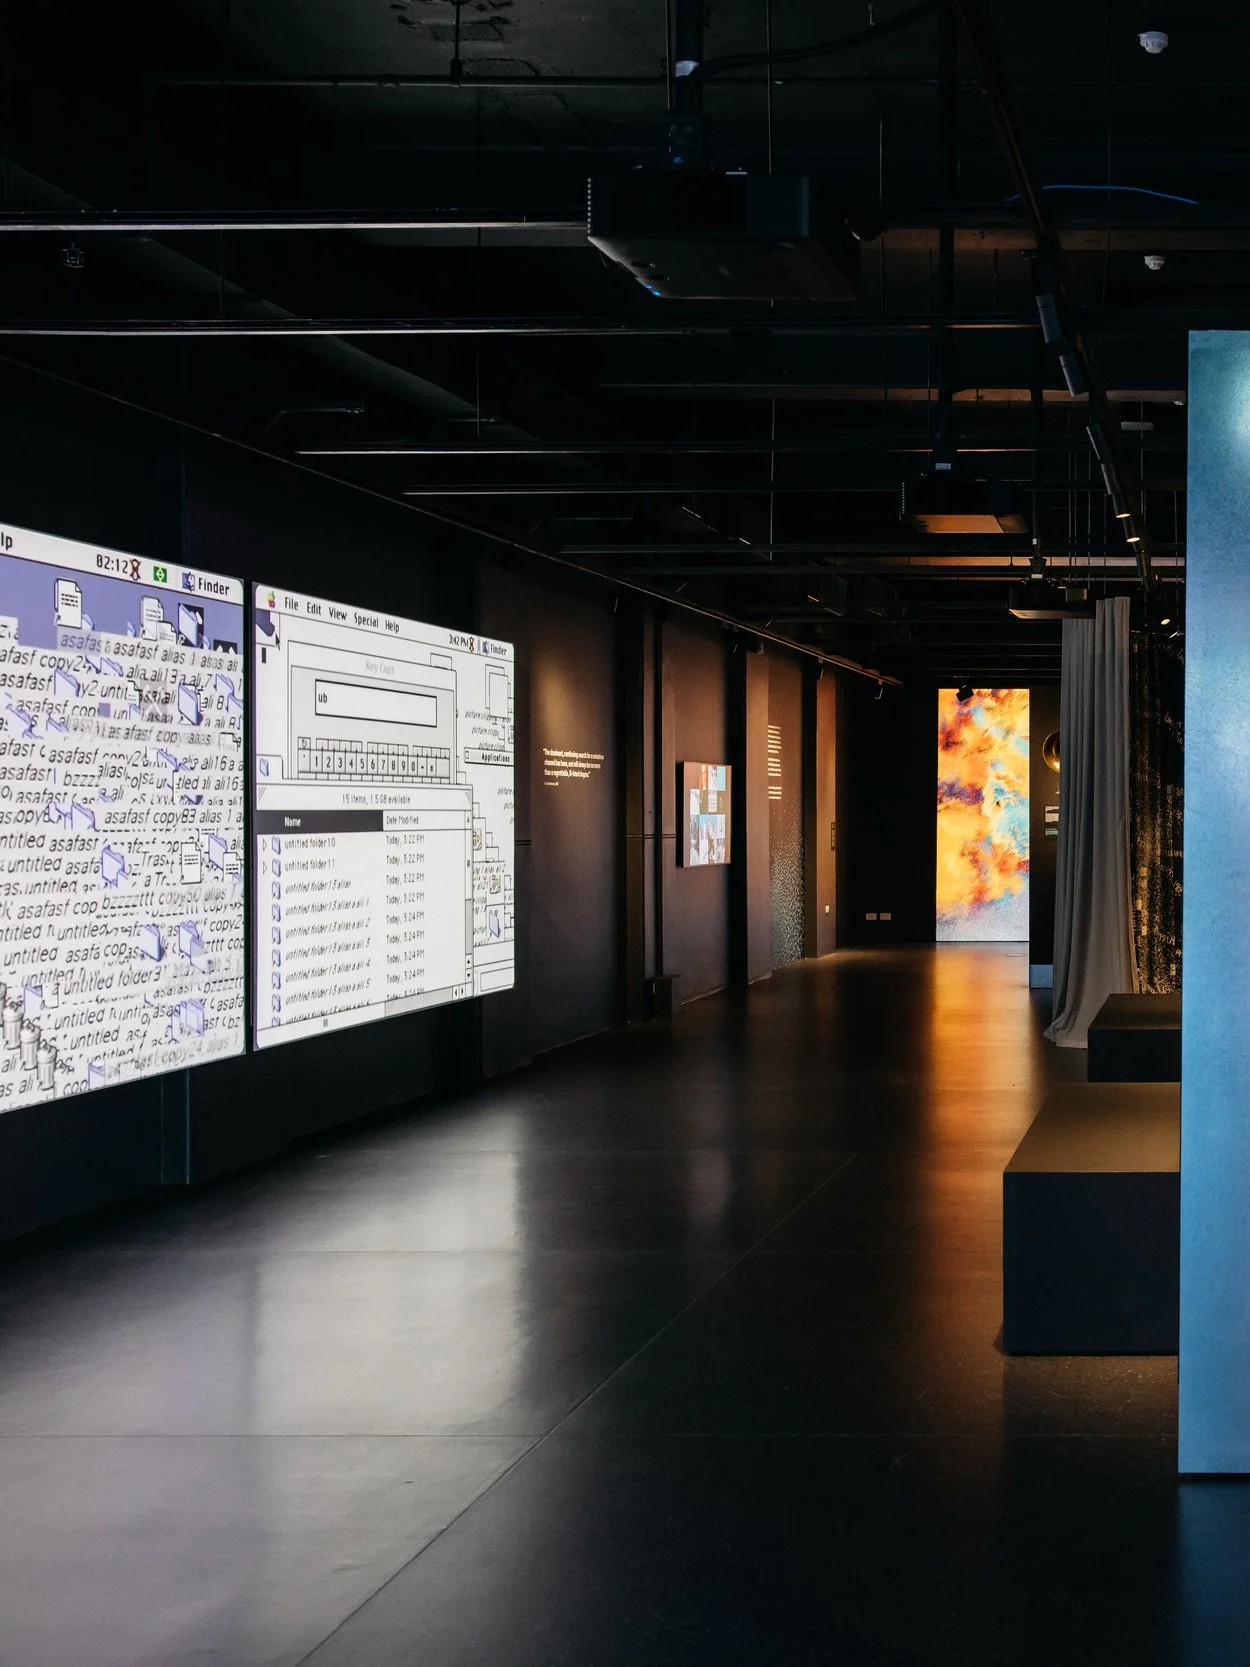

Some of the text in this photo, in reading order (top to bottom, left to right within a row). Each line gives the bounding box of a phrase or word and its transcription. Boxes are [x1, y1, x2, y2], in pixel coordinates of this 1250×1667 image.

[96, 554, 128, 574] 02:12
[198, 577, 230, 596] Finder
[284, 597, 400, 634] File Edit View Special Help
[460, 636, 469, 648] PM
[490, 643, 507, 656] Finder
[365, 660, 395, 677] Key Caps
[318, 692, 328, 703] ub
[315, 756, 319, 767] 1
[326, 756, 331, 768] 2
[338, 757, 343, 768] 3
[349, 757, 354, 768] 4
[360, 758, 365, 769] 5
[371, 759, 376, 770] 6
[381, 759, 386, 770] 7
[391, 760, 396, 771] 8
[401, 760, 406, 771] 9
[481, 752, 510, 763] Applications
[388, 795, 411, 804] available
[284, 816, 301, 827] Name
[386, 815, 419, 825] Date Modified
[4, 946, 58, 967] untitled
[71, 1026, 120, 1050] untitled
